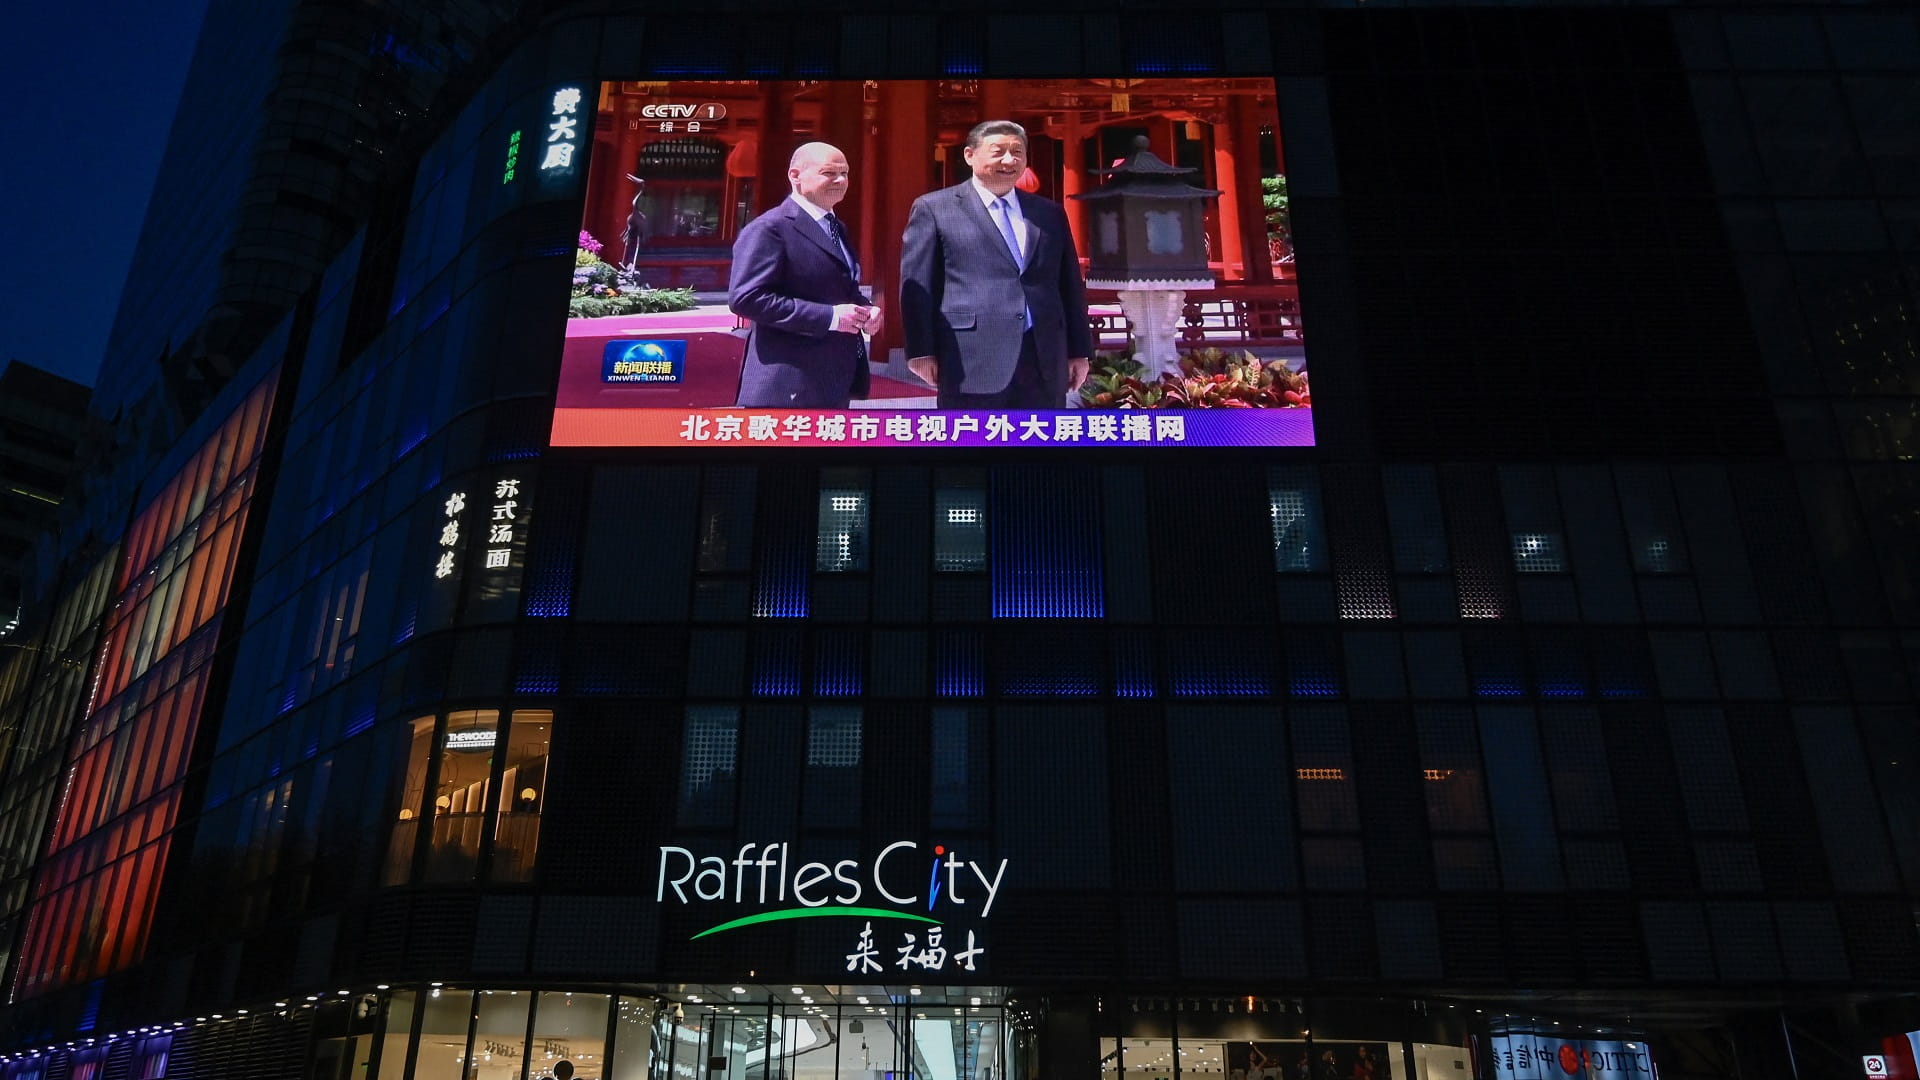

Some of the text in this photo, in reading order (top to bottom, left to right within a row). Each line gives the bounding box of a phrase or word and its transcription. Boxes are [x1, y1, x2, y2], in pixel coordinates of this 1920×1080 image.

[641, 104, 715, 119] CCTV 1
[660, 121, 701, 133] 综合
[613, 361, 673, 375] 新闻联播
[679, 414, 1186, 442] 北京歌华城市电视户外大屏联播网
[486, 479, 521, 569] 苏式汤面
[657, 840, 1008, 918] Raffles City
[846, 921, 985, 974] 来福士
[1868, 1060, 1881, 1069] 24
